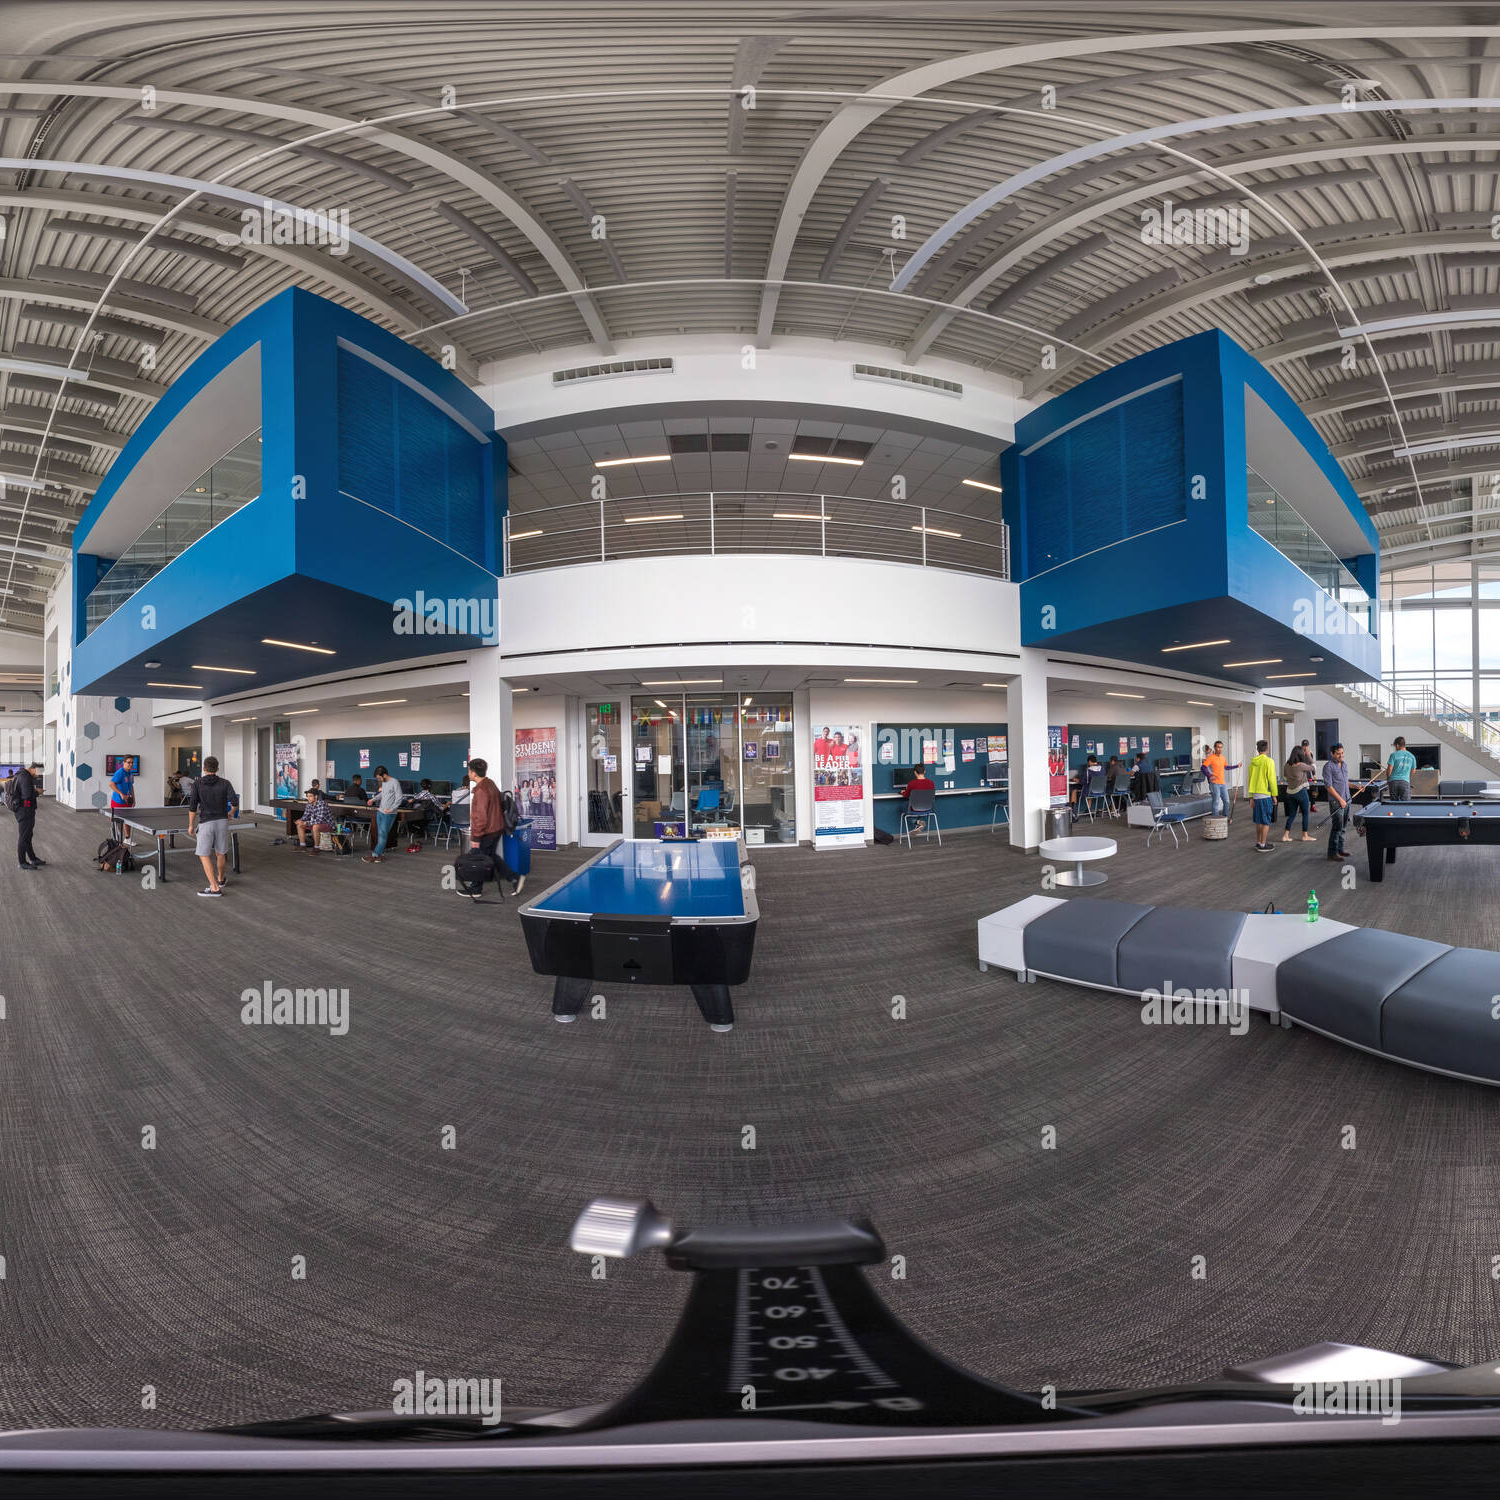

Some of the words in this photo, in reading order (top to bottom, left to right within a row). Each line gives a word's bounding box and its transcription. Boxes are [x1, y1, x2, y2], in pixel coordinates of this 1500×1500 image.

[1048, 736, 1062, 748] IFE
[814, 754, 825, 762] BE
[762, 1276, 799, 1290] 70
[765, 1305, 806, 1319] 60
[768, 1336, 819, 1349] 50
[774, 1367, 837, 1381] 40
